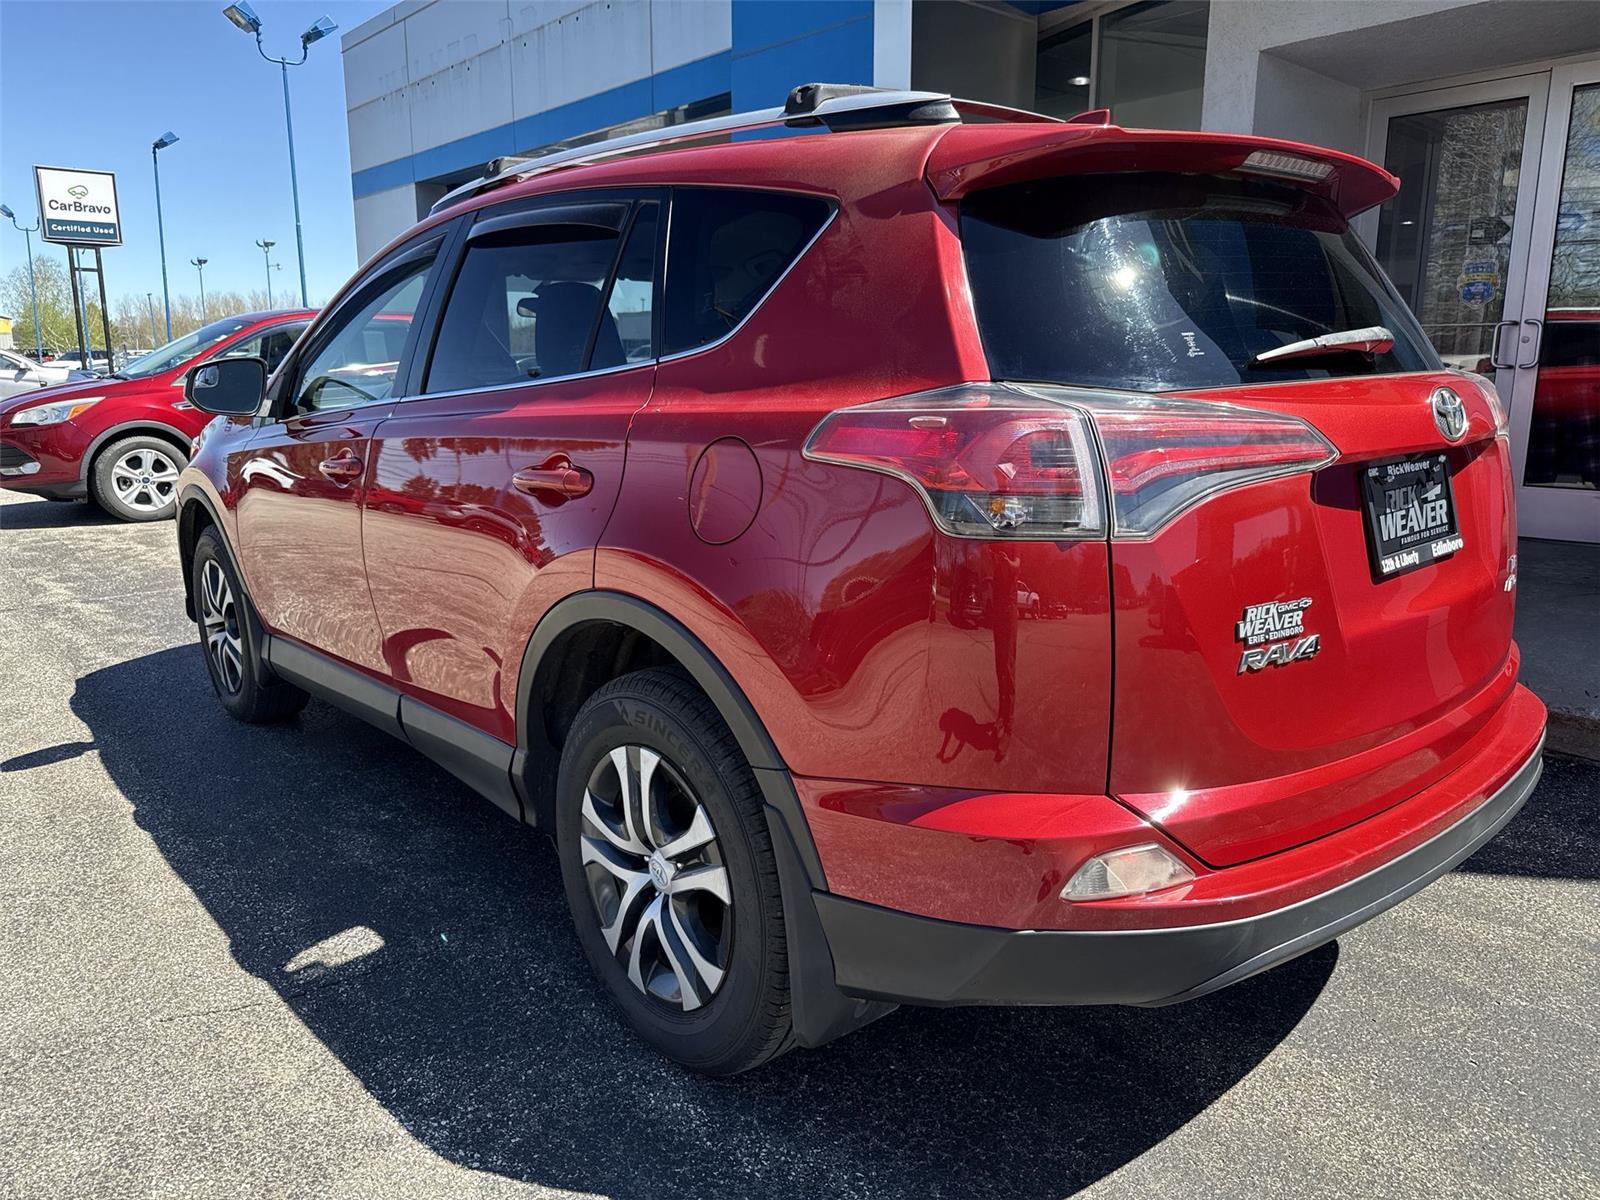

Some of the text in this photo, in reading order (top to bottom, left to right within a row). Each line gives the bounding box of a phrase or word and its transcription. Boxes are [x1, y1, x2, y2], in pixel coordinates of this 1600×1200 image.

[48, 199, 111, 214] CarBravo
[51, 224, 114, 234] Certified Used
[1385, 485, 1418, 510] RICK
[1379, 499, 1448, 541] WEAVER
[1431, 538, 1464, 557] Edinboro
[1246, 602, 1299, 622] RICK GMC
[1239, 610, 1303, 638] WEAVER
[1238, 633, 1321, 673] RAV4
